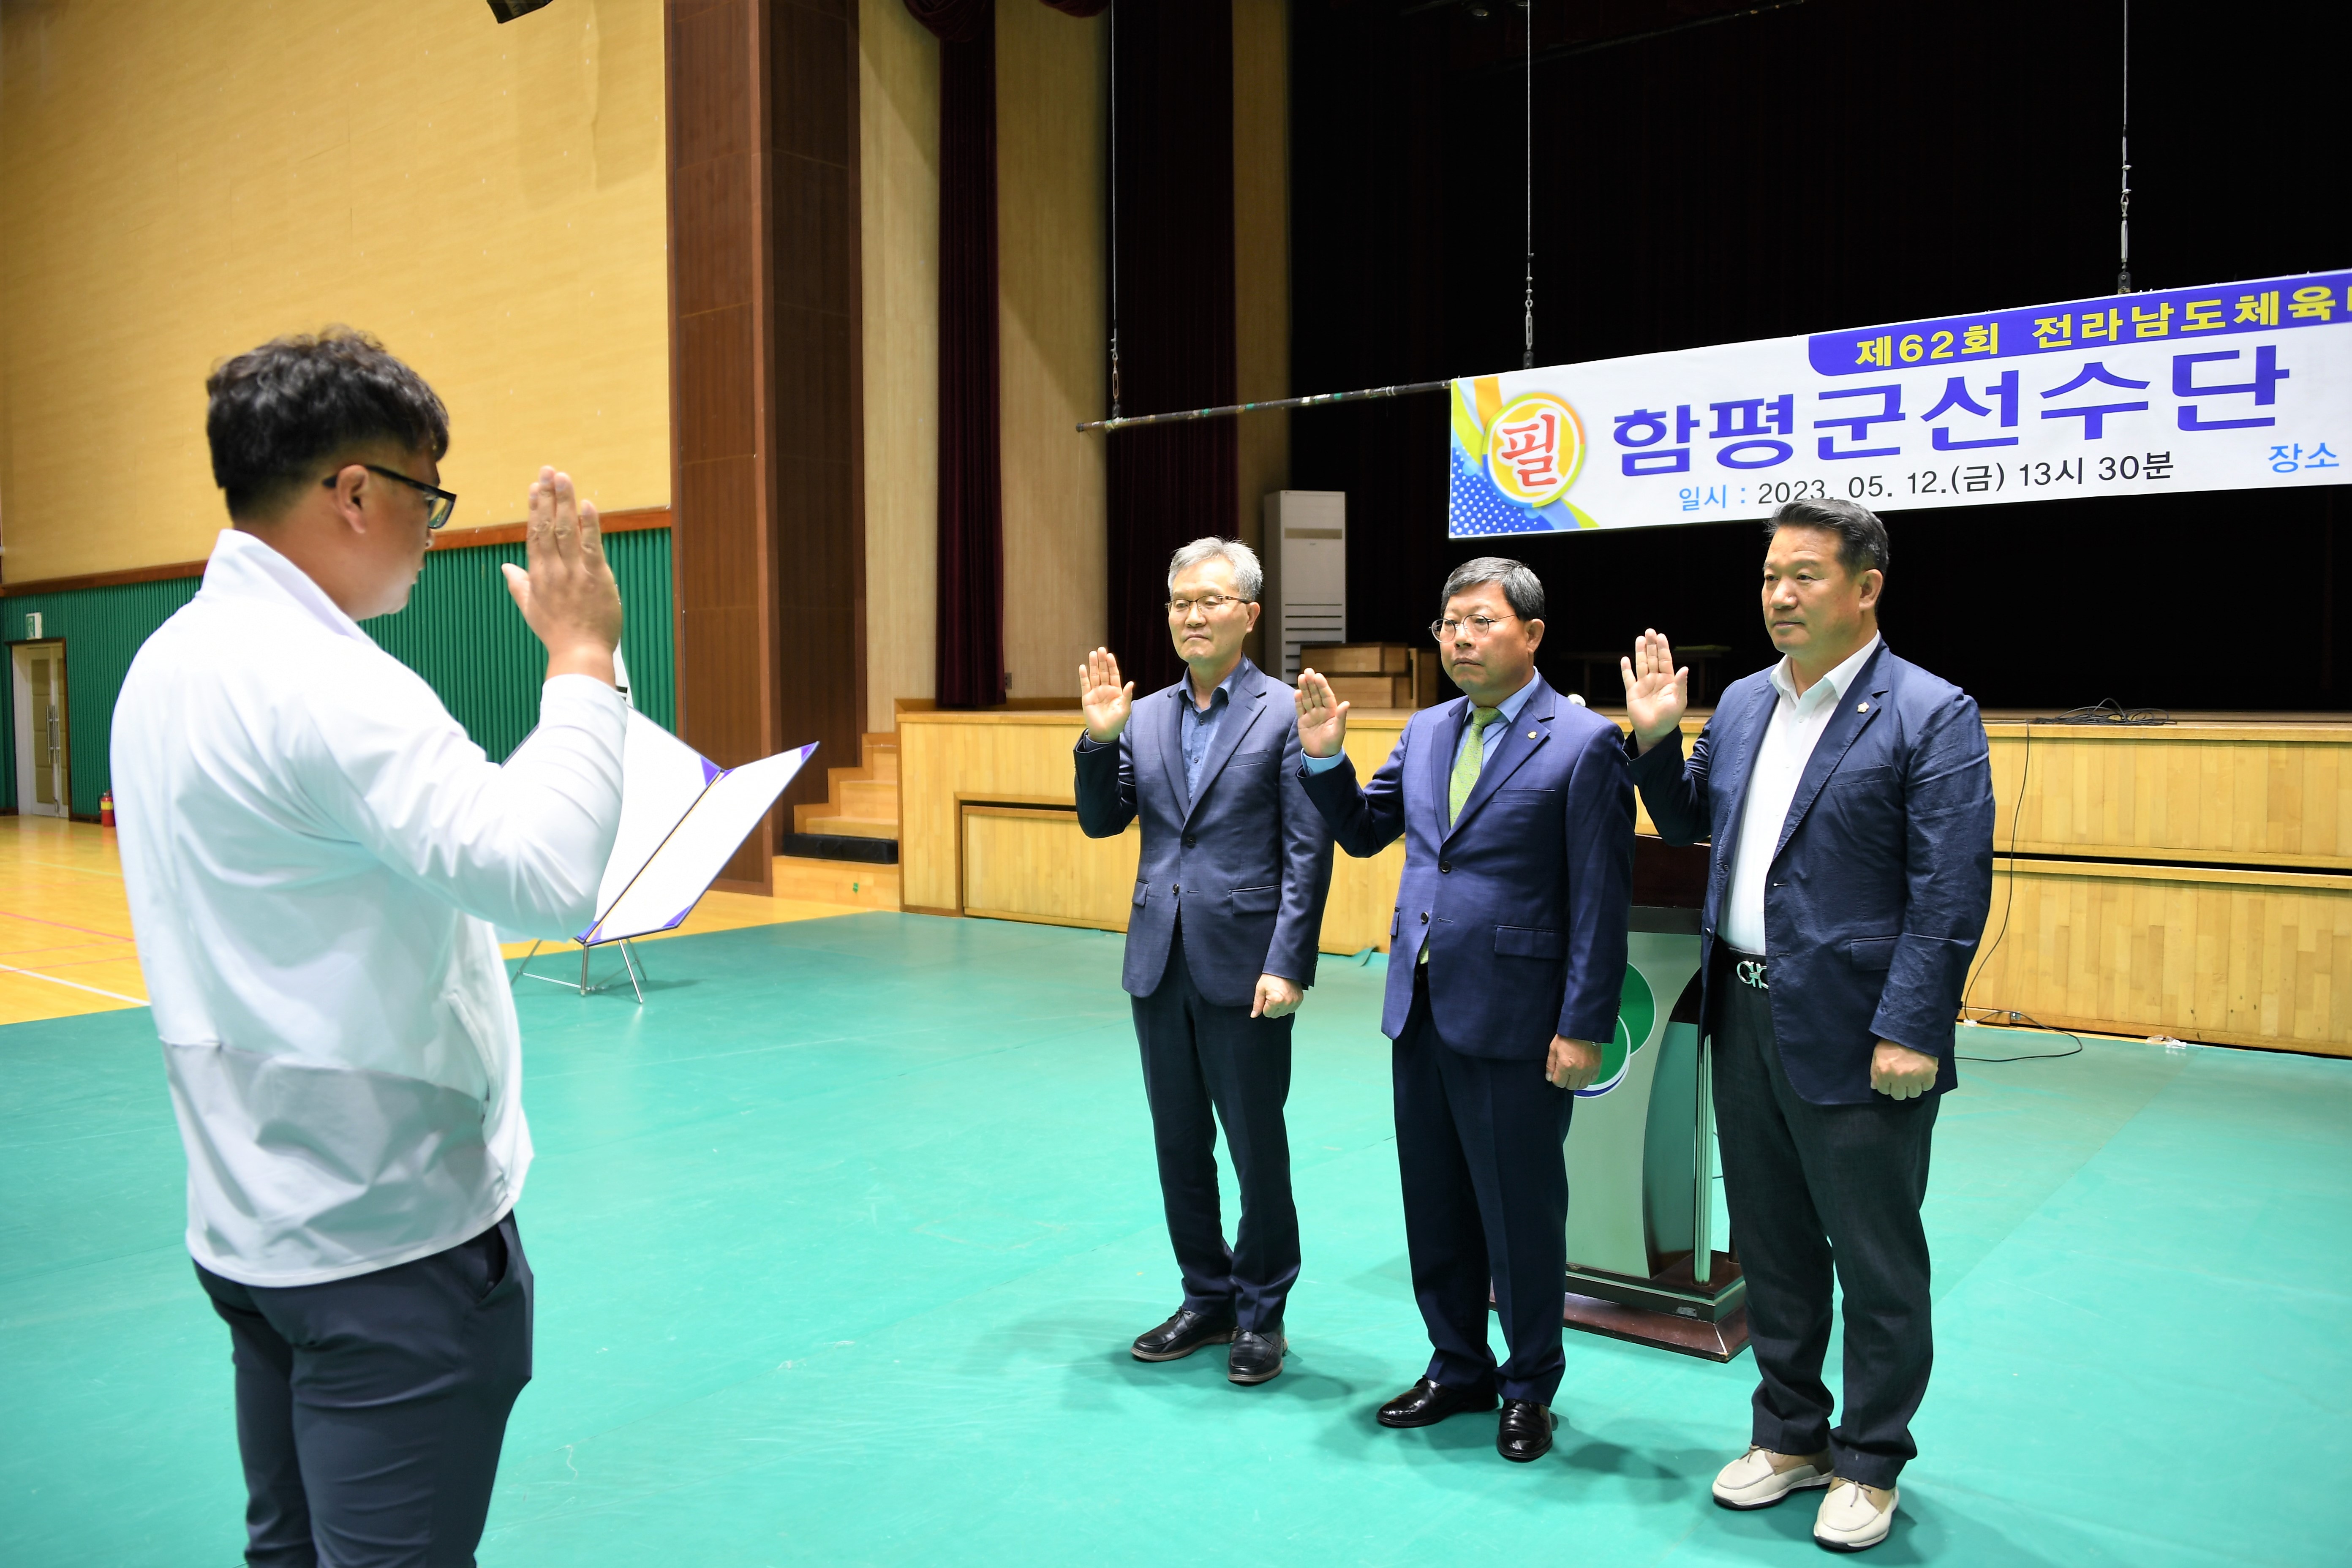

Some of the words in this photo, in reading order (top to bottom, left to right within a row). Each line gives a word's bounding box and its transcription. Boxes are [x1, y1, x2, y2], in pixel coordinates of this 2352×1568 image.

[1855, 322, 1999, 367] 제62회
[2032, 285, 2352, 349] 전라남도체육
[1613, 345, 2290, 476] 함평군선수단
[1501, 414, 1558, 487] 필
[1679, 484, 1727, 512] 일시
[1758, 479, 1834, 504] 2023.
[1848, 475, 1892, 498] 05.
[1908, 462, 2005, 495] 12.(금)
[2019, 457, 2083, 487] 13시
[2098, 451, 2174, 482] 30분
[2268, 442, 2340, 474] 장소
